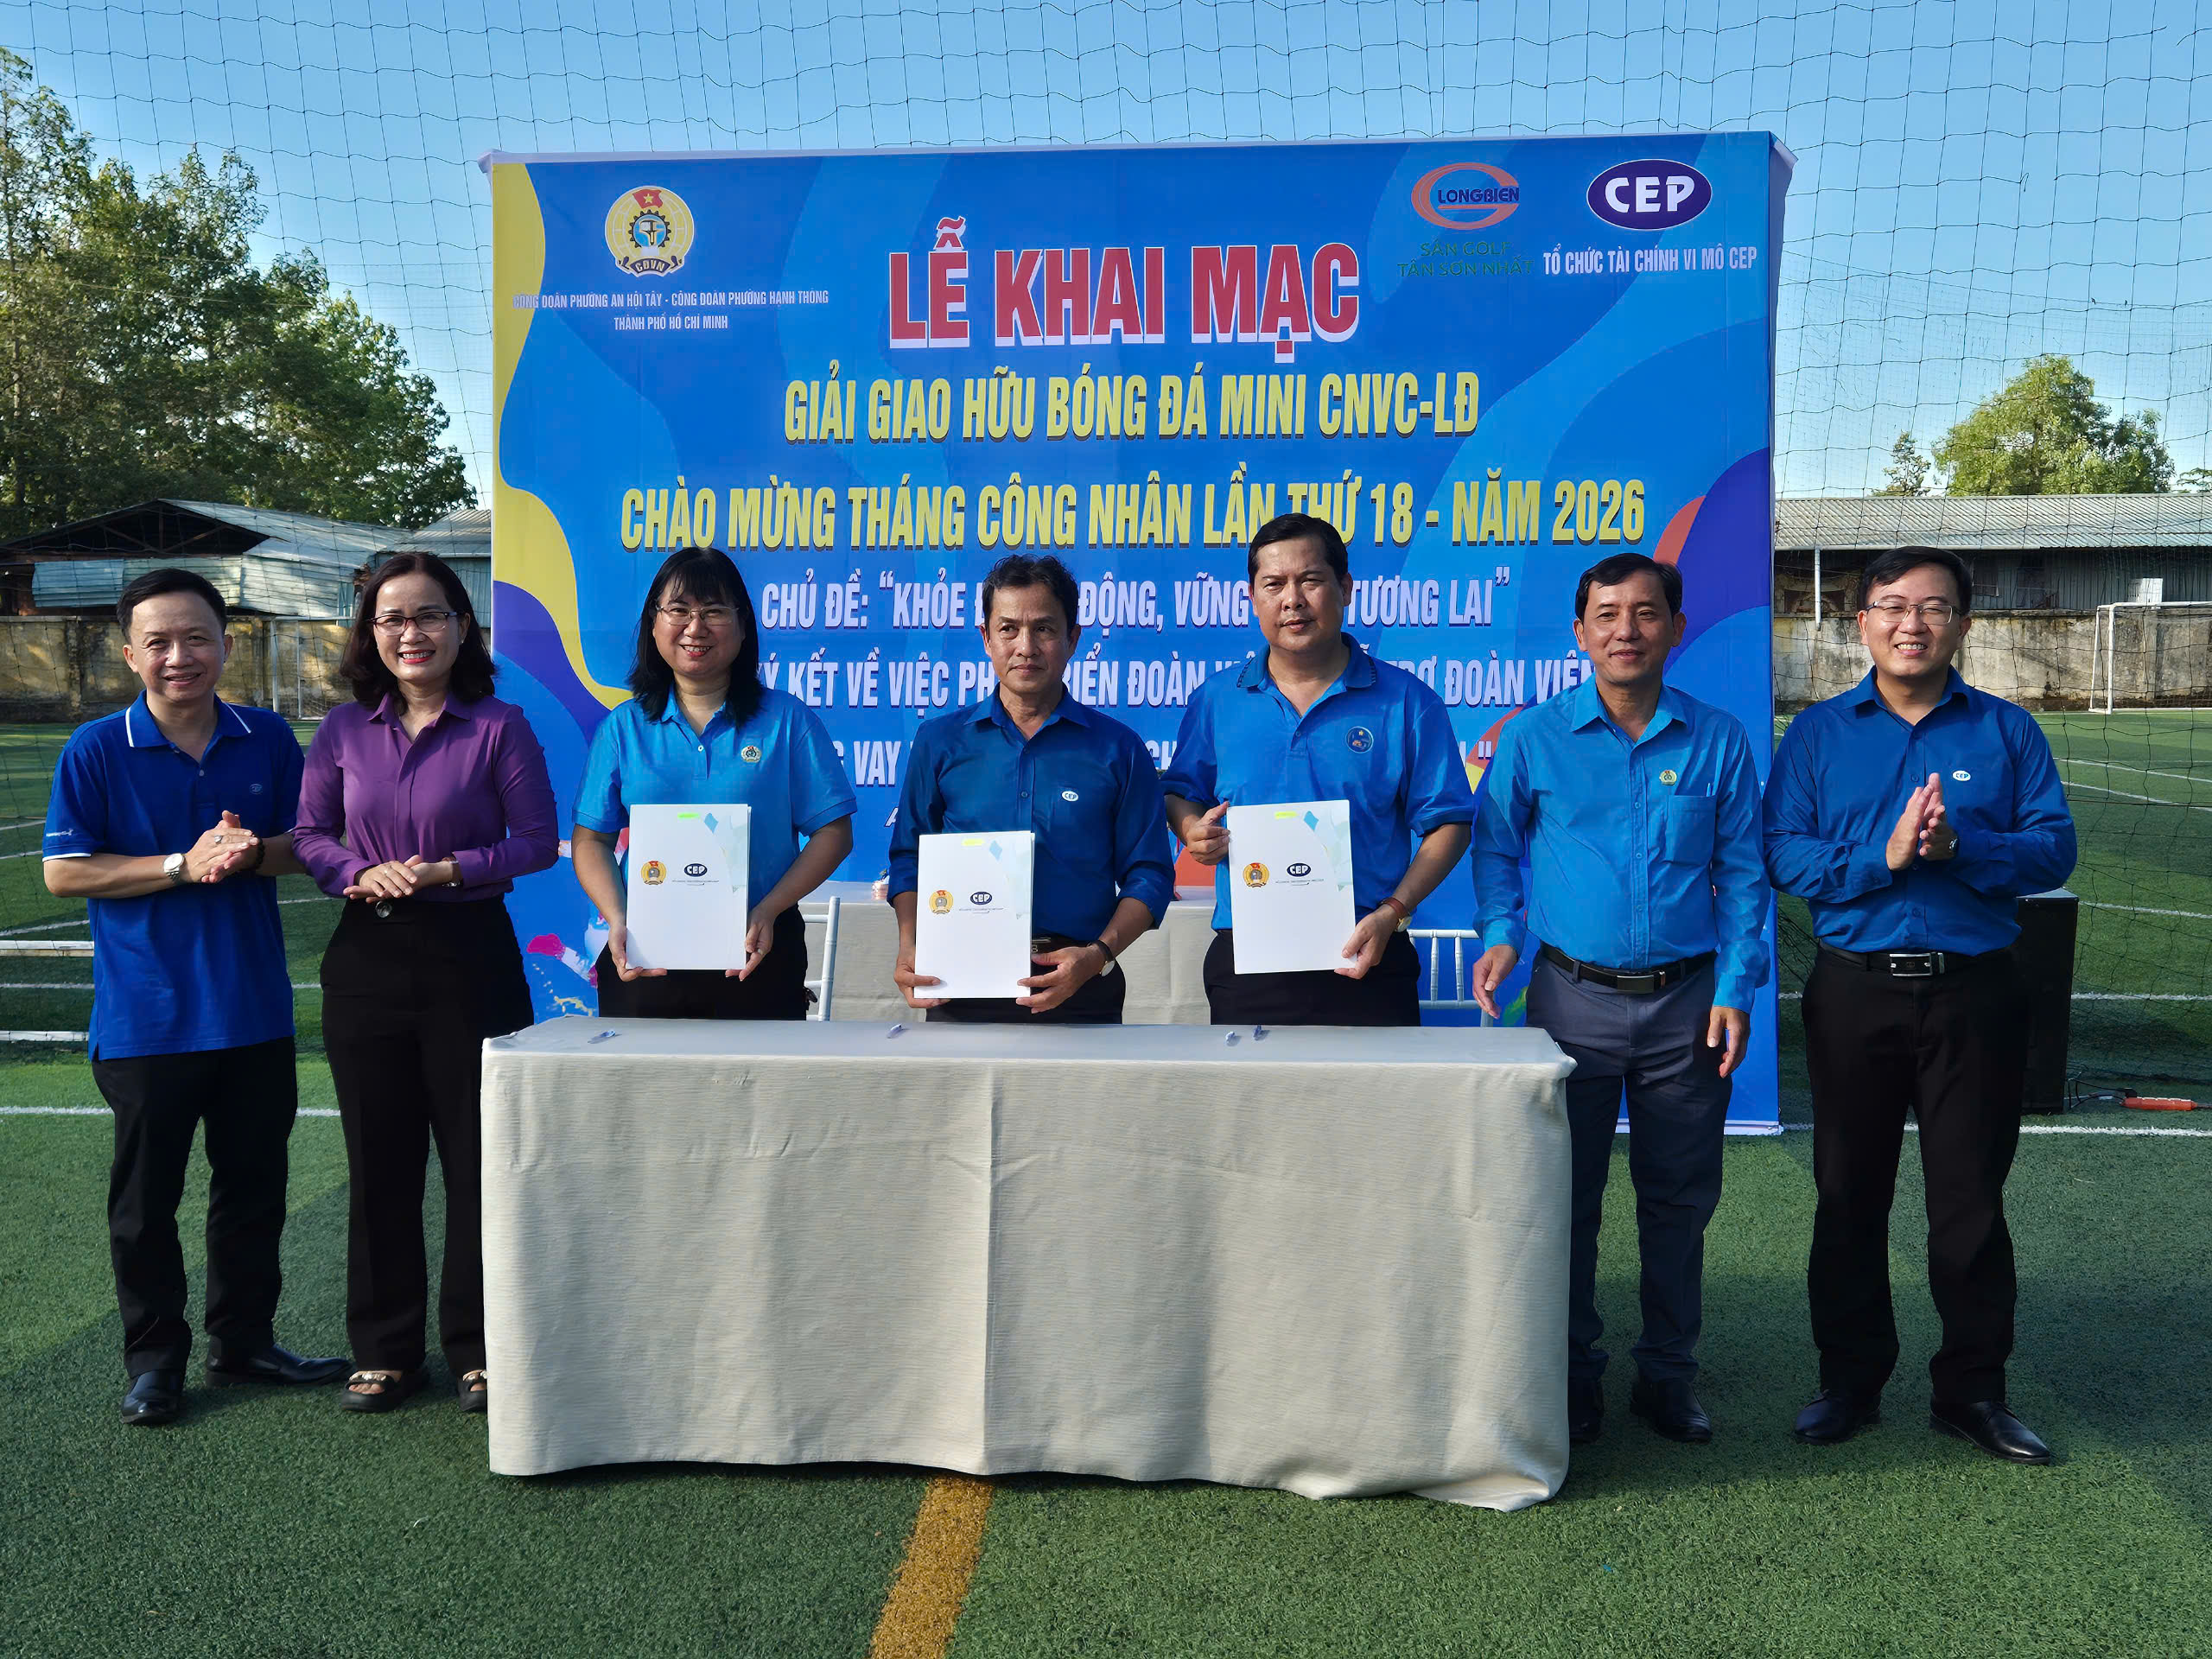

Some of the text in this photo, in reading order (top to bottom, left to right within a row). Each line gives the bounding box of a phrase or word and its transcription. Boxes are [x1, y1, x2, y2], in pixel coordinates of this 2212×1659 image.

[1438, 188, 1520, 203] LONGBIEN
[1605, 175, 1695, 213] CEP
[1397, 256, 1534, 276] TÂN SƠN NHẤT
[1421, 238, 1511, 257] SÂN GOLF
[1543, 243, 1757, 275] TỔ CHỨC TÀI CHÍNH VI MÔ CEP
[611, 293, 624, 307] AN
[889, 215, 1360, 364] LỄ KHAI MẠC
[702, 315, 728, 329] MINH
[785, 359, 1478, 445] GIẢI GIAO HỮU BÓNG ĐÁ MINI CNVC-LĐ
[620, 475, 716, 552] CHÀO
[727, 474, 836, 552] MỪNG
[848, 473, 965, 551] THÁNG
[976, 472, 1077, 551] CÔNG
[1088, 469, 1192, 550] NHÂN
[1204, 461, 1275, 548] LẦN
[1370, 482, 1413, 548] 18
[1425, 510, 1439, 527] -
[1452, 467, 1541, 547] NĂM
[1553, 480, 1644, 546] 2026
[761, 568, 817, 628] CHỦ
[825, 568, 868, 629] ĐỀ:
[1174, 571, 1249, 627] VỮNG
[1347, 575, 1440, 627] TƯƠNG
[787, 647, 839, 709] KẾT
[847, 646, 880, 709] VỀ
[888, 652, 950, 719] VIỆC
[1127, 651, 1205, 708] ĐOÀN
[1444, 650, 1525, 708] ĐOÀN
[853, 741, 901, 787] VAY
